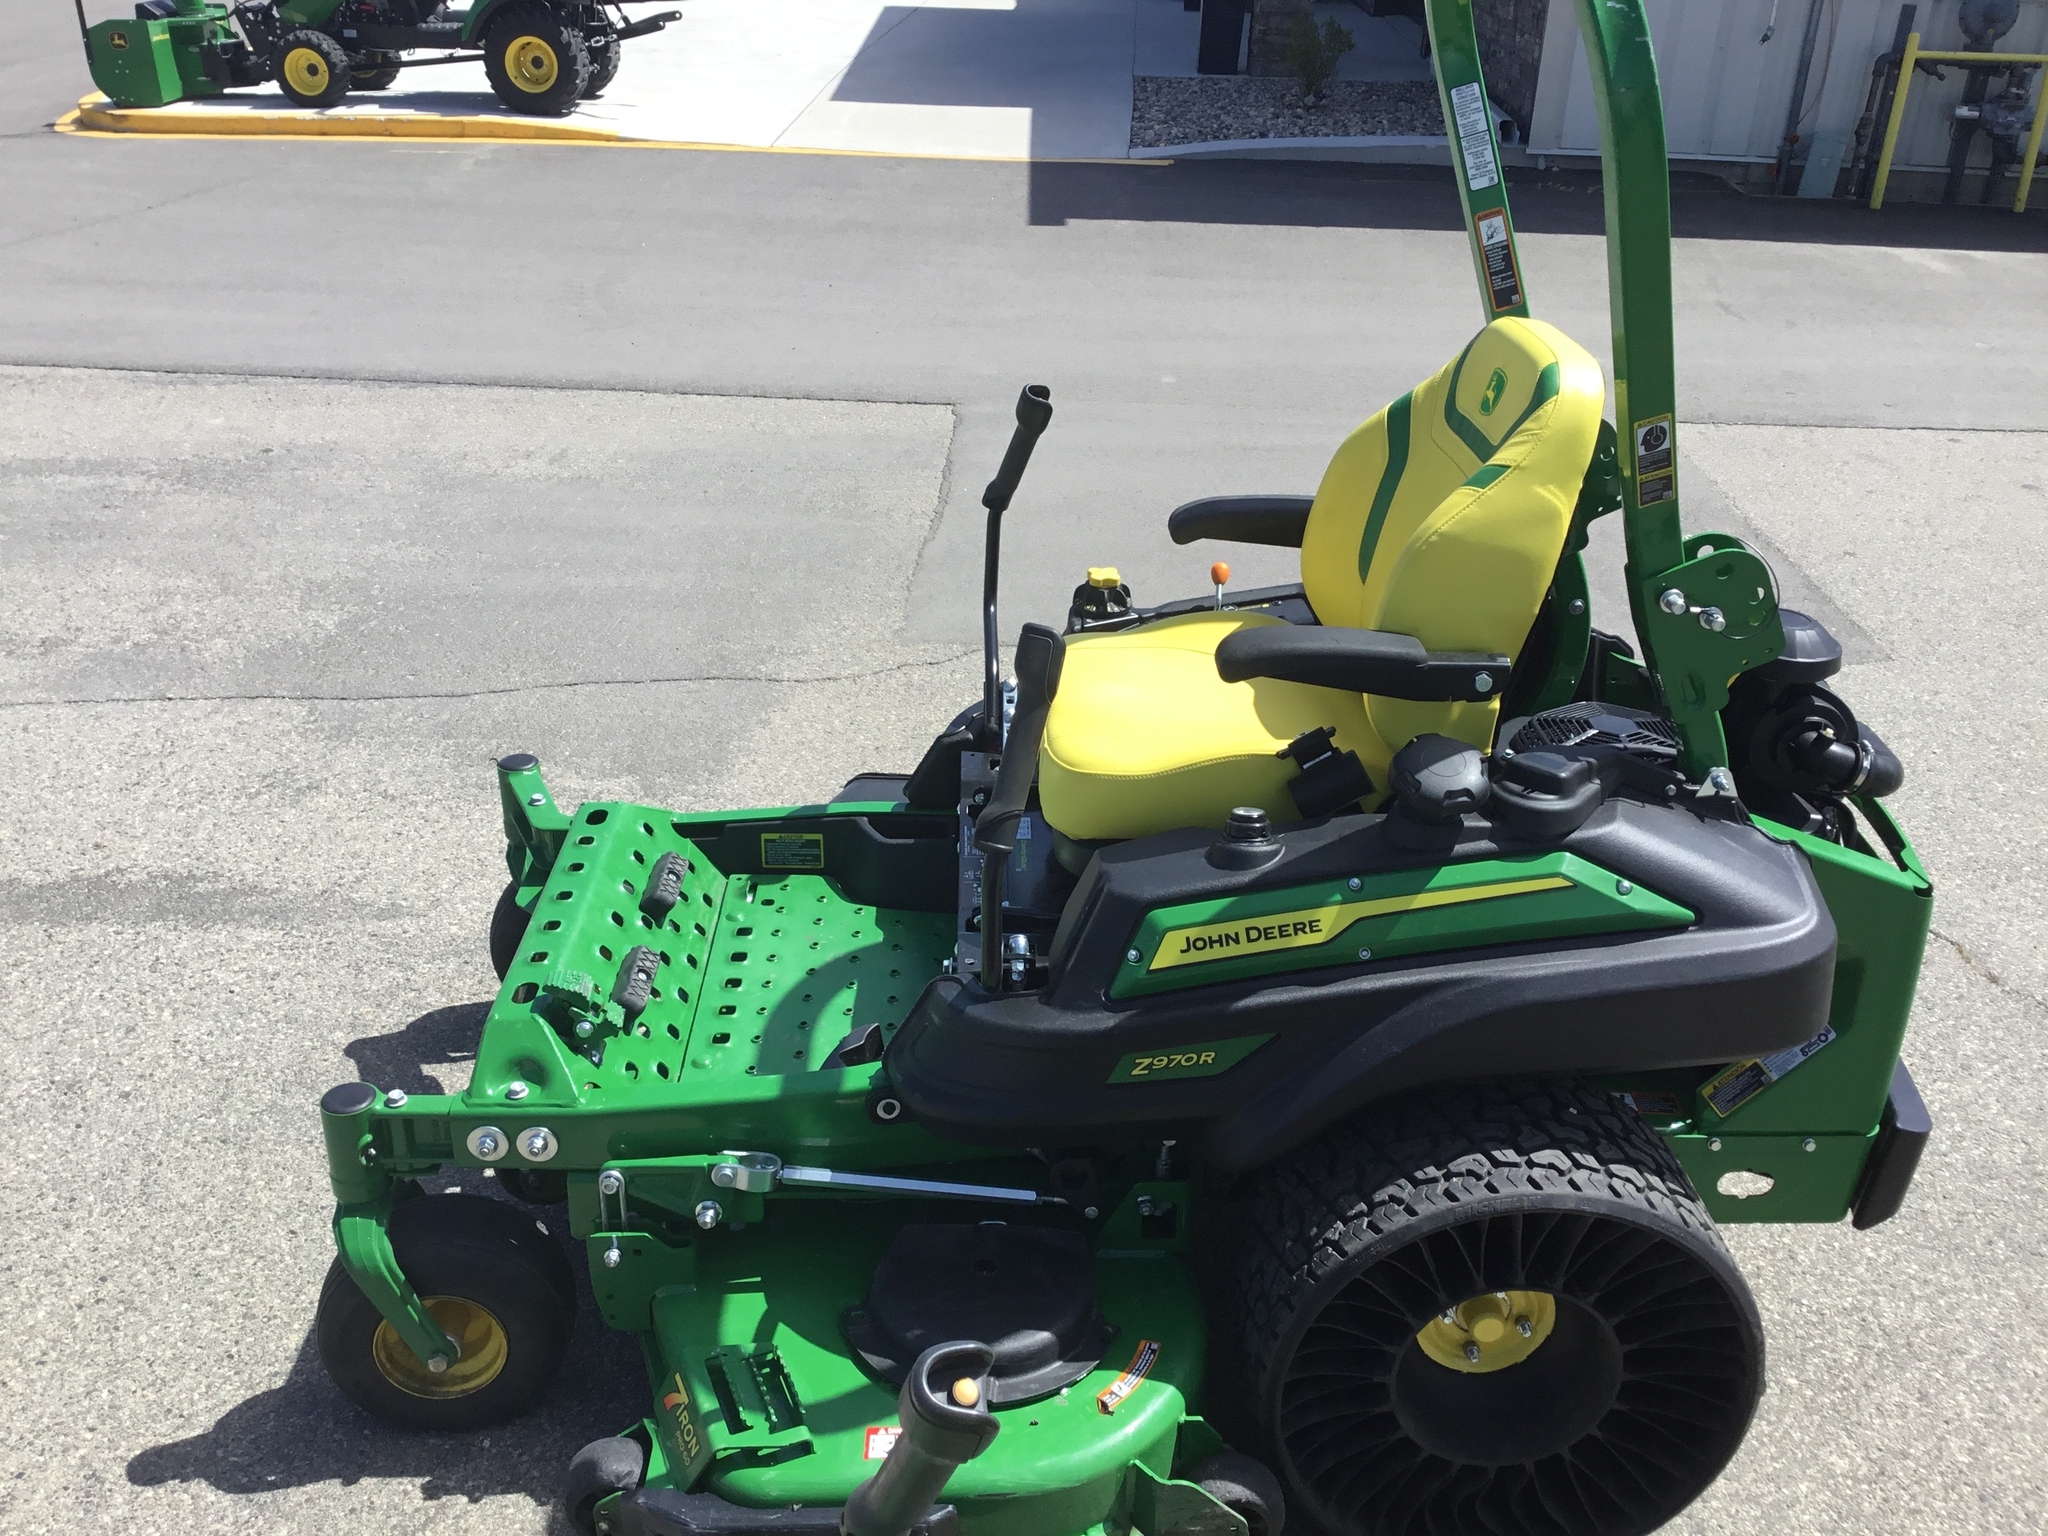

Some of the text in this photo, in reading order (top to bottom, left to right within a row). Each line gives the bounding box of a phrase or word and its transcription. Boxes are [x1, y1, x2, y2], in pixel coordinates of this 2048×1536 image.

[1643, 415, 1669, 425] CAUTION
[1180, 919, 1323, 954] JOHN DEERE
[1130, 1051, 1216, 1076] Z970R
[675, 1430, 684, 1451] PRO
